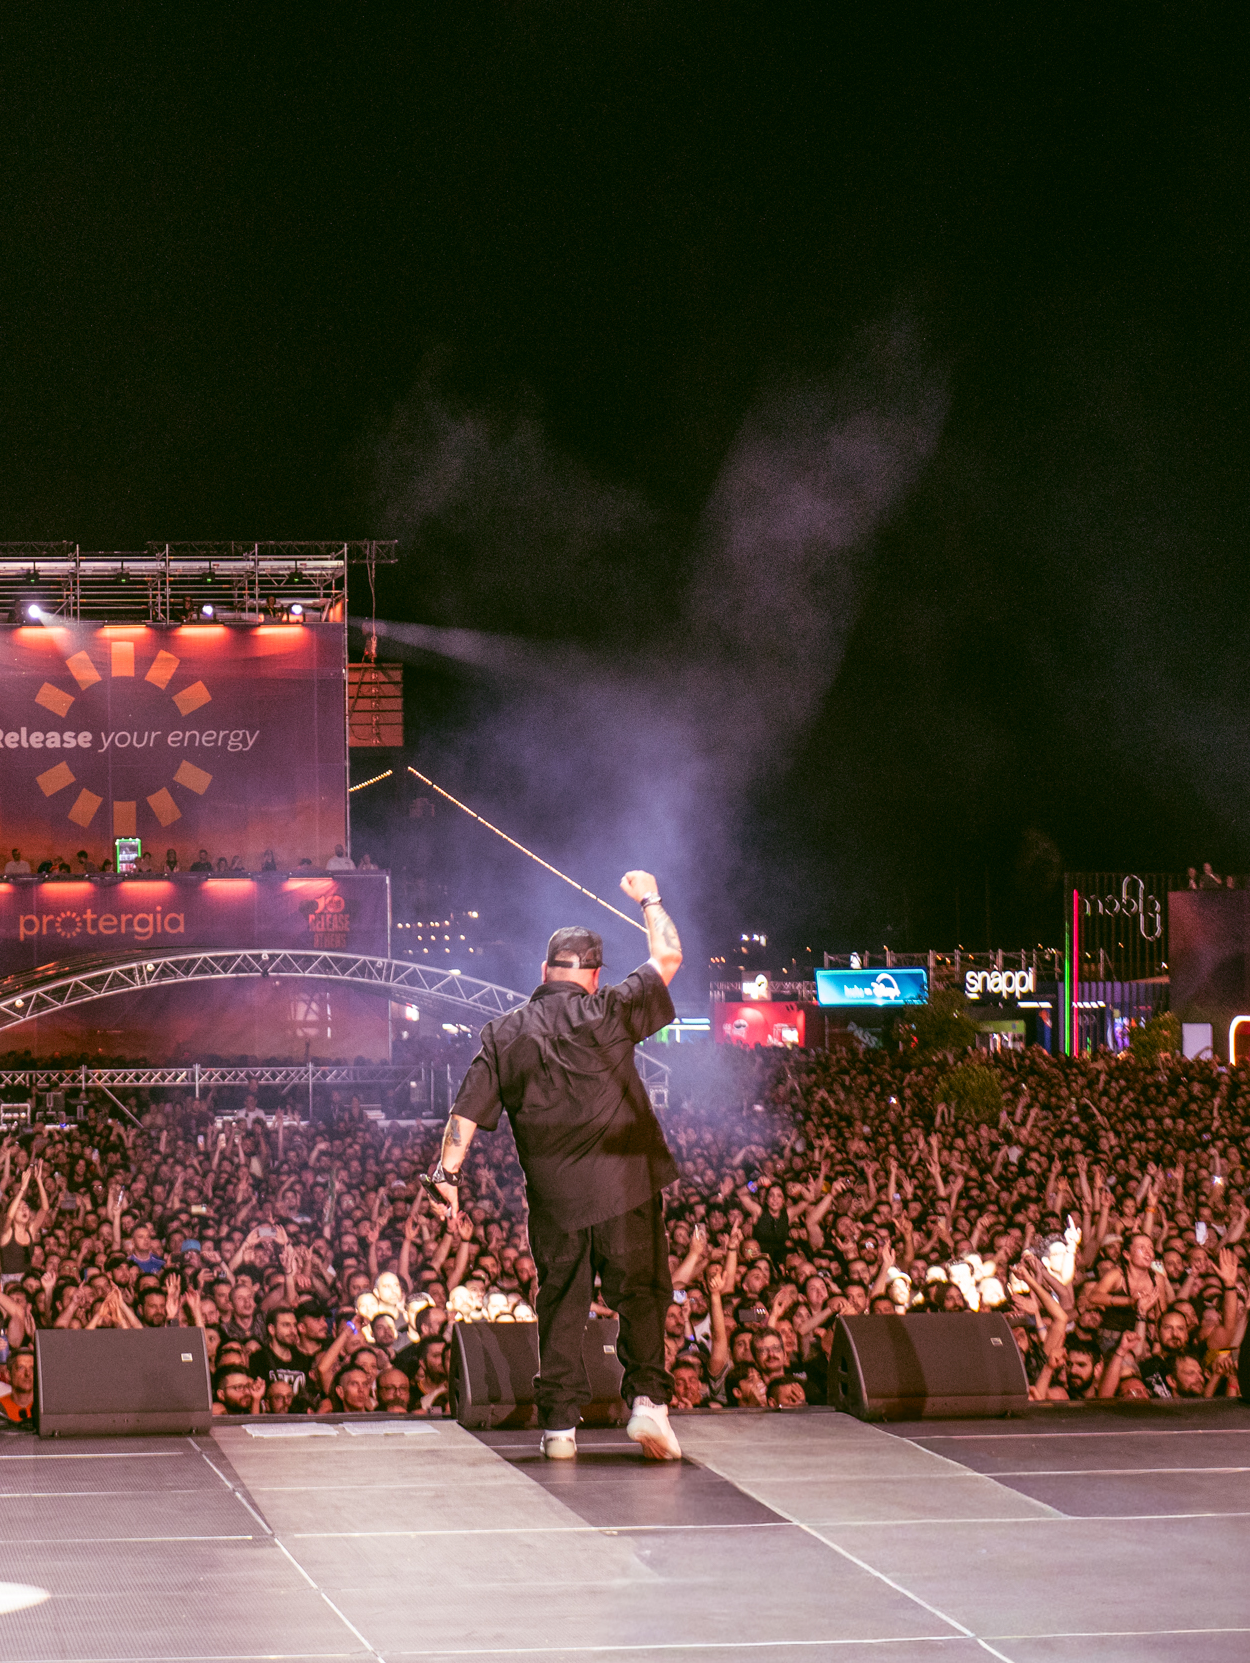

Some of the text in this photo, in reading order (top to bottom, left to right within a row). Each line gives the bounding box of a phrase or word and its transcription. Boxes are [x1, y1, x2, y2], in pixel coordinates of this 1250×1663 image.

[98, 731, 161, 752] your
[167, 729, 260, 752] energy
[19, 905, 185, 942] protergia
[964, 966, 1035, 1000] snappi
